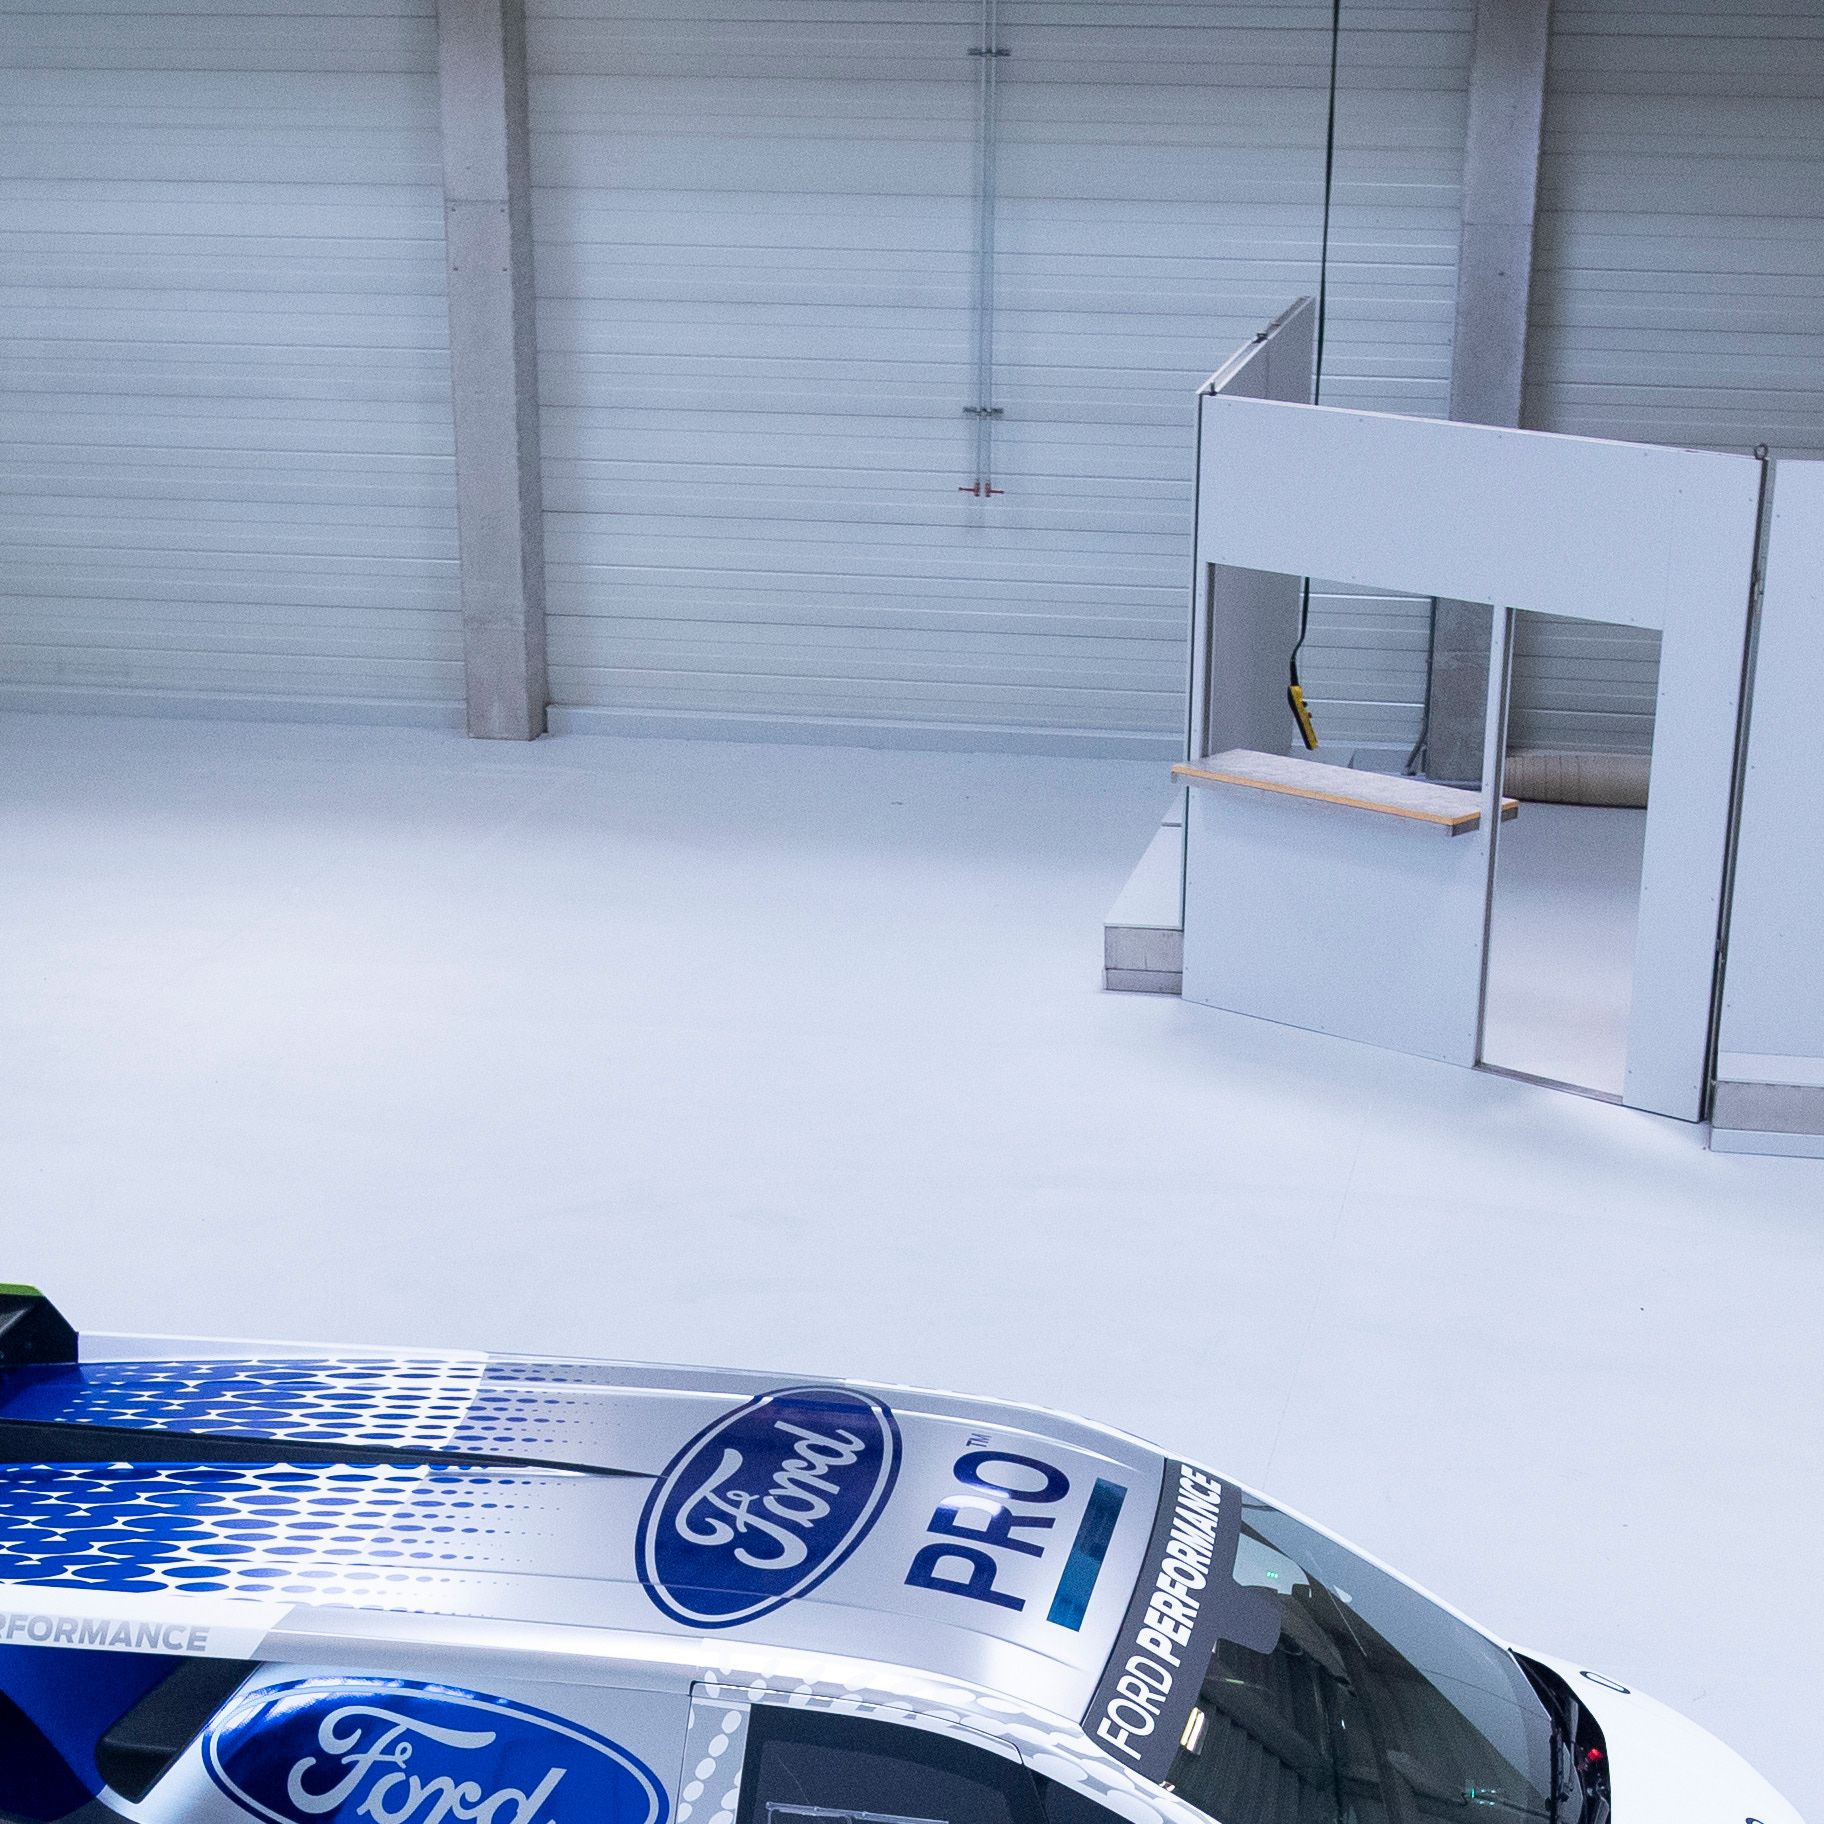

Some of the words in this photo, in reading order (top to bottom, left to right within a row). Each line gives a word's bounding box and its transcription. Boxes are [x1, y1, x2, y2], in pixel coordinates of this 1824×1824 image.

[675, 1420, 866, 1570] Ford
[1096, 1654, 1175, 1762] FORD
[1136, 1464, 1223, 1668] PERFORMANCE
